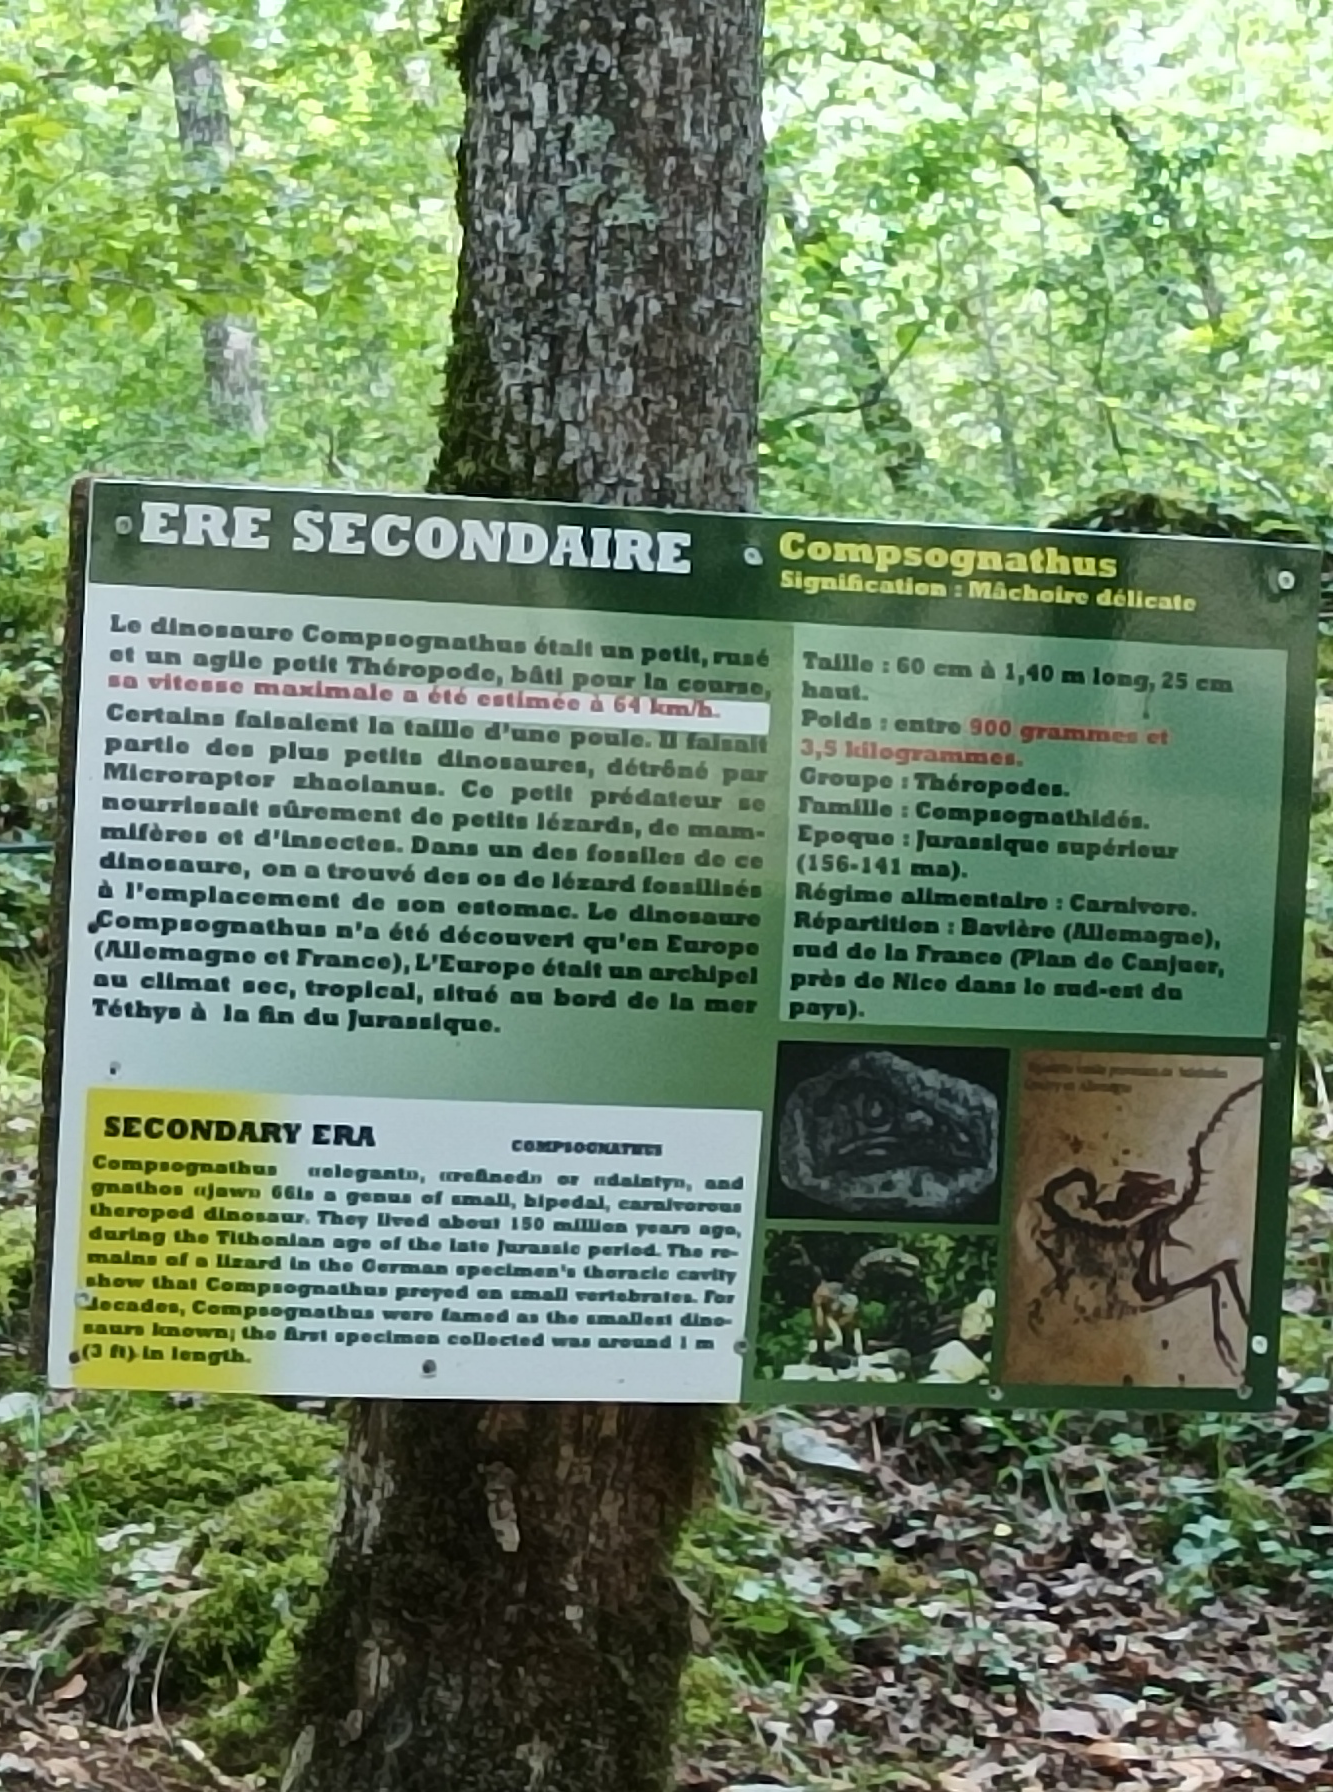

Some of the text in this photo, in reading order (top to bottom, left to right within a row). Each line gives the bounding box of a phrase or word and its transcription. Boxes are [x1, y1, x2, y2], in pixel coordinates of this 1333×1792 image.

[140, 501, 692, 574] ERE SECONDAIRE
[779, 532, 1118, 579] Compsognathus
[780, 571, 948, 599] Signification
[968, 579, 1088, 605] Mâchoire
[1096, 586, 1197, 611] délicate
[109, 614, 769, 666] Le dinosaure Compsognathus était un petit, rusé
[108, 646, 770, 698] et un agile petit Théropode, bâti pour la course,
[801, 649, 874, 673] Taille
[895, 654, 926, 675] 60
[932, 660, 974, 678] cm
[980, 659, 997, 679] à
[1004, 660, 1055, 684] 1,40
[1060, 667, 1087, 684] m
[1091, 665, 1155, 691] long,
[1160, 668, 1190, 689] 25
[1194, 674, 1235, 691] cm
[107, 672, 720, 717] sa vitesse maximale a été estimée à 64 km/h.
[800, 678, 870, 701] haut.
[800, 706, 872, 729] Poids
[893, 714, 962, 733] entre
[969, 715, 1012, 736] 900
[1019, 721, 1137, 742] grammes
[1146, 726, 1169, 743] et
[799, 736, 1023, 766] 3,5 kilogrammes.
[799, 765, 893, 792] Groupe
[912, 771, 1070, 798] Théropodes.
[797, 794, 893, 816] Famille
[914, 799, 1149, 828] Compsognathidés.
[797, 824, 894, 849] Epoque
[915, 829, 1049, 856] Jurassique
[1055, 837, 1179, 859] supérieur
[795, 852, 968, 879] (156-141 ma).
[97, 880, 760, 925] à l'emplacement de son estomac. Le dinosaure
[795, 881, 893, 905] Régime
[900, 887, 1049, 909] alimentaire
[1068, 893, 1196, 915] Carnivore.
[94, 909, 759, 958] Compsognathus n'a été découvert qu'en Europe
[793, 910, 940, 933] Répartition
[960, 917, 1056, 938] Bavière
[1061, 921, 1220, 948] (Allemagne),
[93, 939, 757, 987] (Allemagne et France), L'Europe était un archipel
[792, 940, 1224, 976] sud de la France (Plan de Canjuer,
[92, 971, 757, 1011] au climat sec, tropical, situé au bord de la mer
[790, 969, 1184, 999] près de Nice dans le sud-est du
[91, 998, 500, 1035] Téthys à la fin du Jurassique.
[788, 998, 864, 1018] pays).
[104, 1115, 376, 1147] SECONDARY ERA
